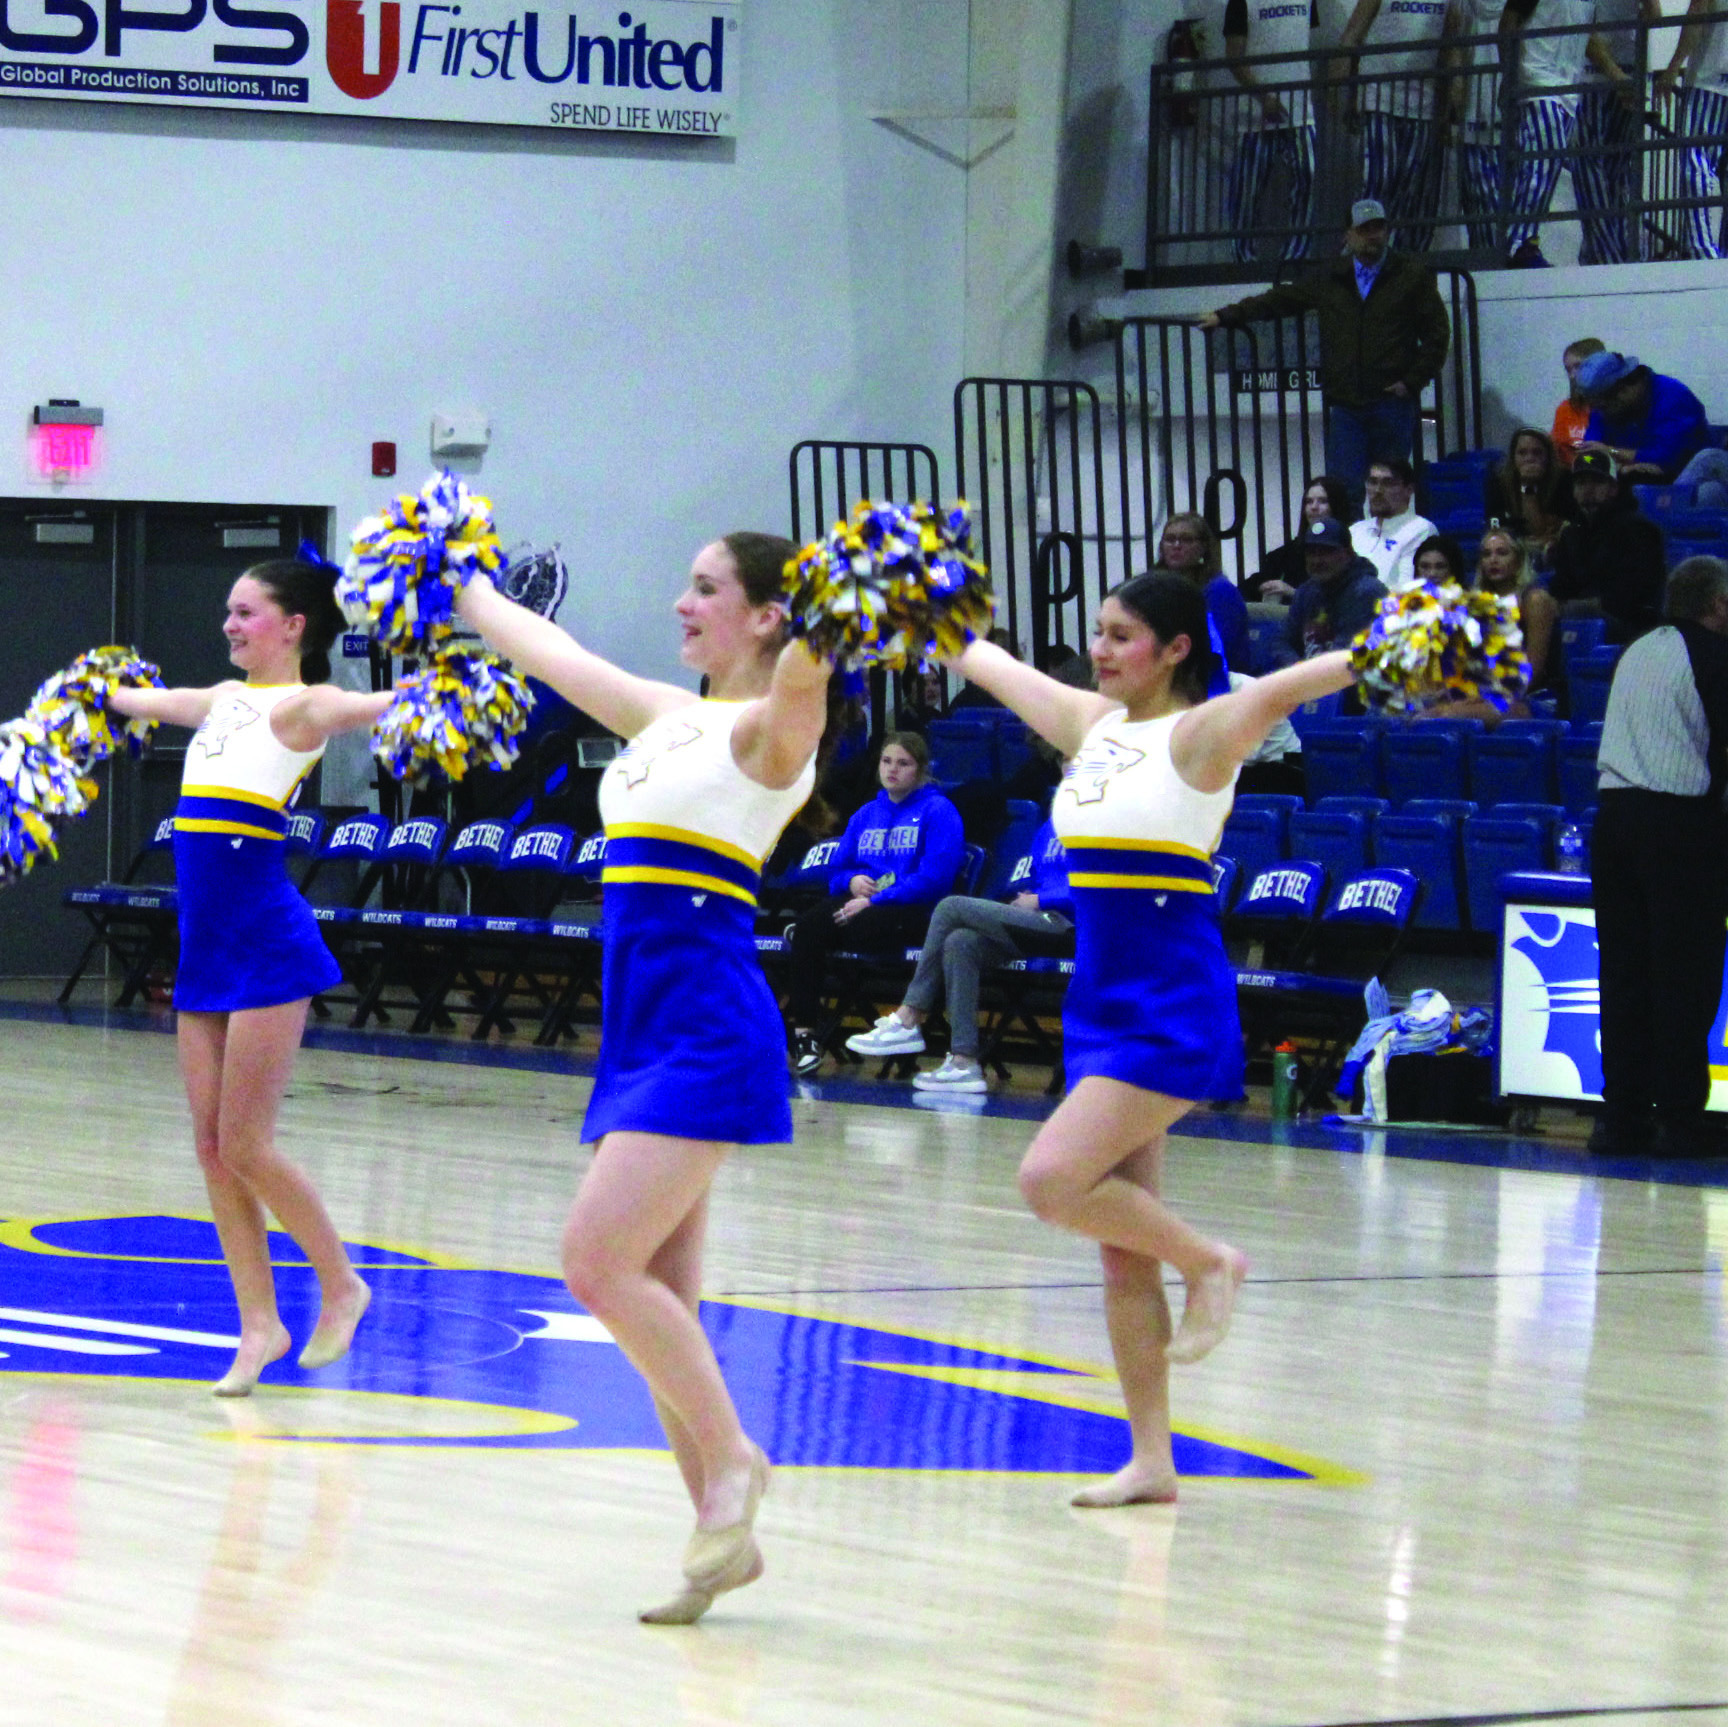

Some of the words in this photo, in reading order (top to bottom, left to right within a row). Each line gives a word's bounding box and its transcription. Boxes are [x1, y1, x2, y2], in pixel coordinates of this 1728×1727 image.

[1258, 4, 1307, 20] ROCKETS
[1390, 0, 1445, 15] ROCKETS
[0, 65, 64, 84] Global
[72, 69, 171, 90] Production
[178, 76, 265, 96] Solutions,
[272, 80, 299, 97] Inc
[550, 102, 610, 127] SPEND
[617, 106, 651, 129] LIFE
[657, 109, 721, 133] WISELY
[1242, 371, 1277, 389] HM
[344, 640, 369, 651] EXIT
[289, 815, 315, 842] THEL
[329, 822, 380, 851] BETHEL
[387, 822, 438, 849] BETHEL
[453, 824, 505, 852] BETHEL
[860, 827, 917, 848] BETHEL
[510, 831, 563, 861] BETHEL
[577, 836, 608, 864] BET
[801, 842, 840, 870] BET
[1248, 870, 1312, 904] BETHEL
[1337, 879, 1403, 916] BETHEL
[362, 913, 402, 925] WILDCATS
[424, 917, 458, 929] WILDCATS
[486, 919, 517, 931] WILDCATS
[552, 924, 589, 938] WILDCATS
[1237, 973, 1276, 987] WILDCATS
